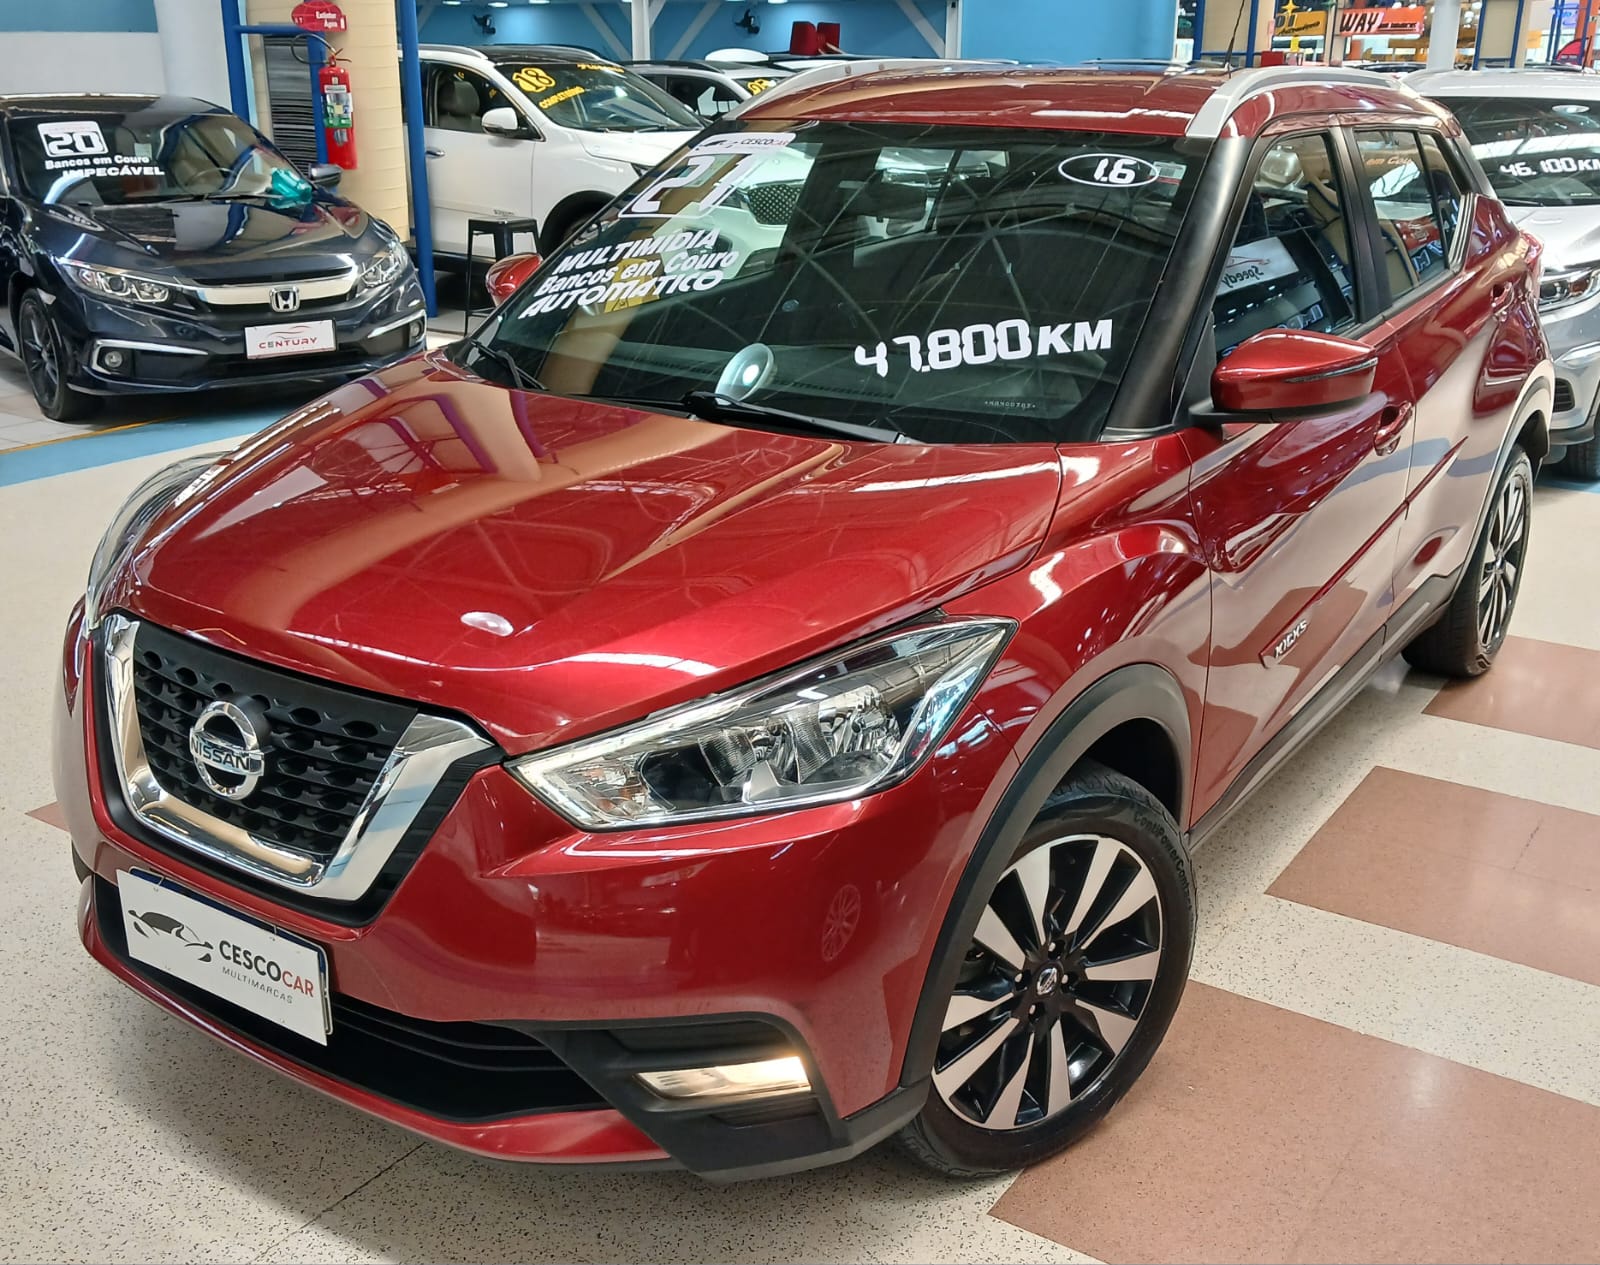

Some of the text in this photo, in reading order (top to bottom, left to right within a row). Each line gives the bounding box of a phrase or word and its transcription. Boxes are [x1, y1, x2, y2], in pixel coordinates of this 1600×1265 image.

[1340, 12, 1380, 32] WAY
[512, 67, 556, 92] 18
[48, 132, 105, 156] 20
[45, 154, 150, 170] Bancos em Couro
[62, 165, 165, 178] IMPECÁVEL
[631, 153, 753, 213] 21
[534, 250, 740, 297] Bancos em Couro
[258, 337, 318, 349] CENTURY
[1274, 619, 1307, 658] KICKS
[191, 734, 250, 771] NISSAN
[218, 939, 315, 998] CESCOCAR
[222, 966, 293, 1004] MULTIMARCAS
